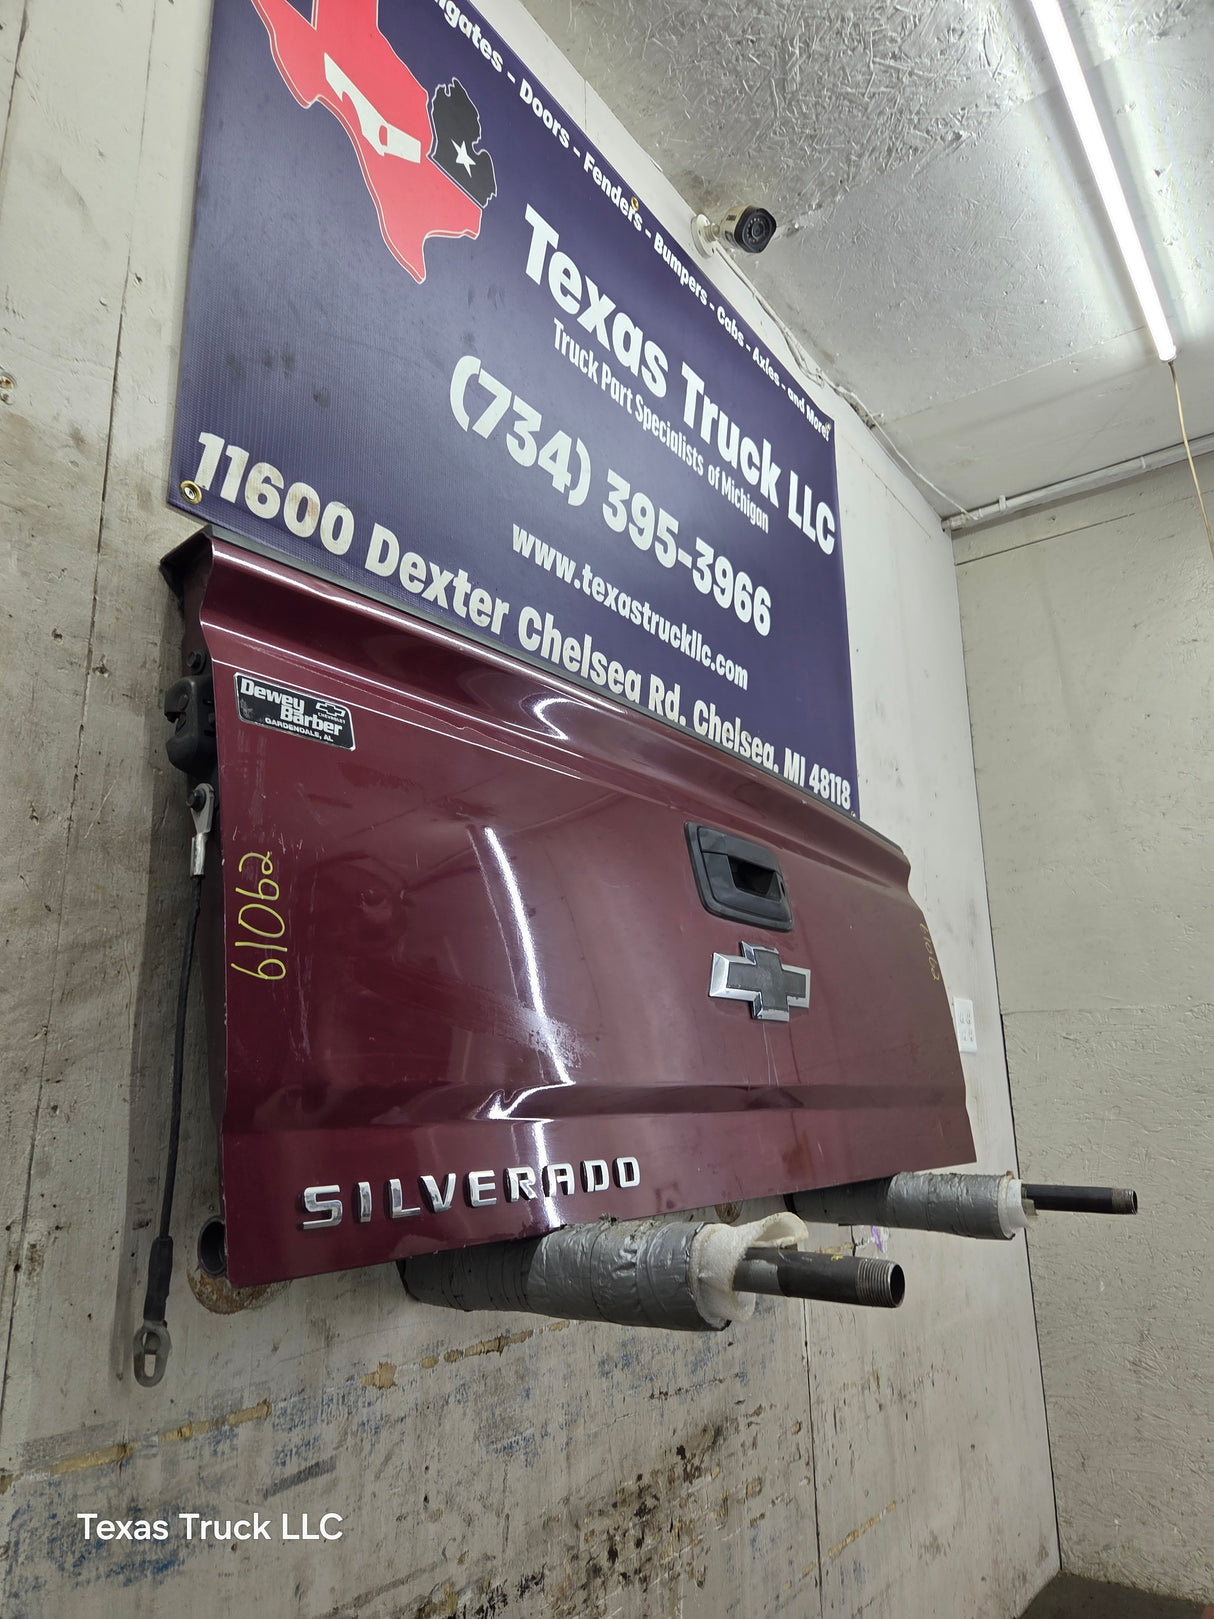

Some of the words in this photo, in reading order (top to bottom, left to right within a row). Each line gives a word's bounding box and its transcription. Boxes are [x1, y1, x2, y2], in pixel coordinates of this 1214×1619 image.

[434, 0, 503, 72] gates
[519, 79, 570, 149] Doors
[583, 152, 643, 231] Fenders
[653, 232, 708, 306] Bumpers
[717, 305, 745, 346] Cabs
[752, 346, 781, 389] Axles
[788, 387, 805, 414] and
[524, 203, 669, 398] Texas
[681, 362, 780, 508] Truck
[788, 470, 836, 555] LLC
[553, 318, 599, 385] Truck
[601, 372, 636, 415] Part
[635, 396, 705, 477] Specialists
[708, 463, 722, 491] of
[721, 475, 770, 534] Michigan
[449, 355, 592, 507] (734)
[602, 468, 772, 637] 395-3966
[195, 431, 355, 556] 11600
[364, 522, 510, 635] Dexter
[518, 606, 642, 705] Chelsea
[648, 674, 687, 726] Rd.
[784, 747, 806, 789] MI
[808, 763, 852, 811] 48118
[512, 523, 749, 691] www.texastruckllc.com
[240, 677, 305, 714] Dewey
[264, 717, 322, 740] GARDENDALE,
[323, 734, 334, 742] AL
[280, 704, 343, 736] Barber
[230, 850, 288, 980] 61062
[301, 1156, 641, 1231] SILVERADO
